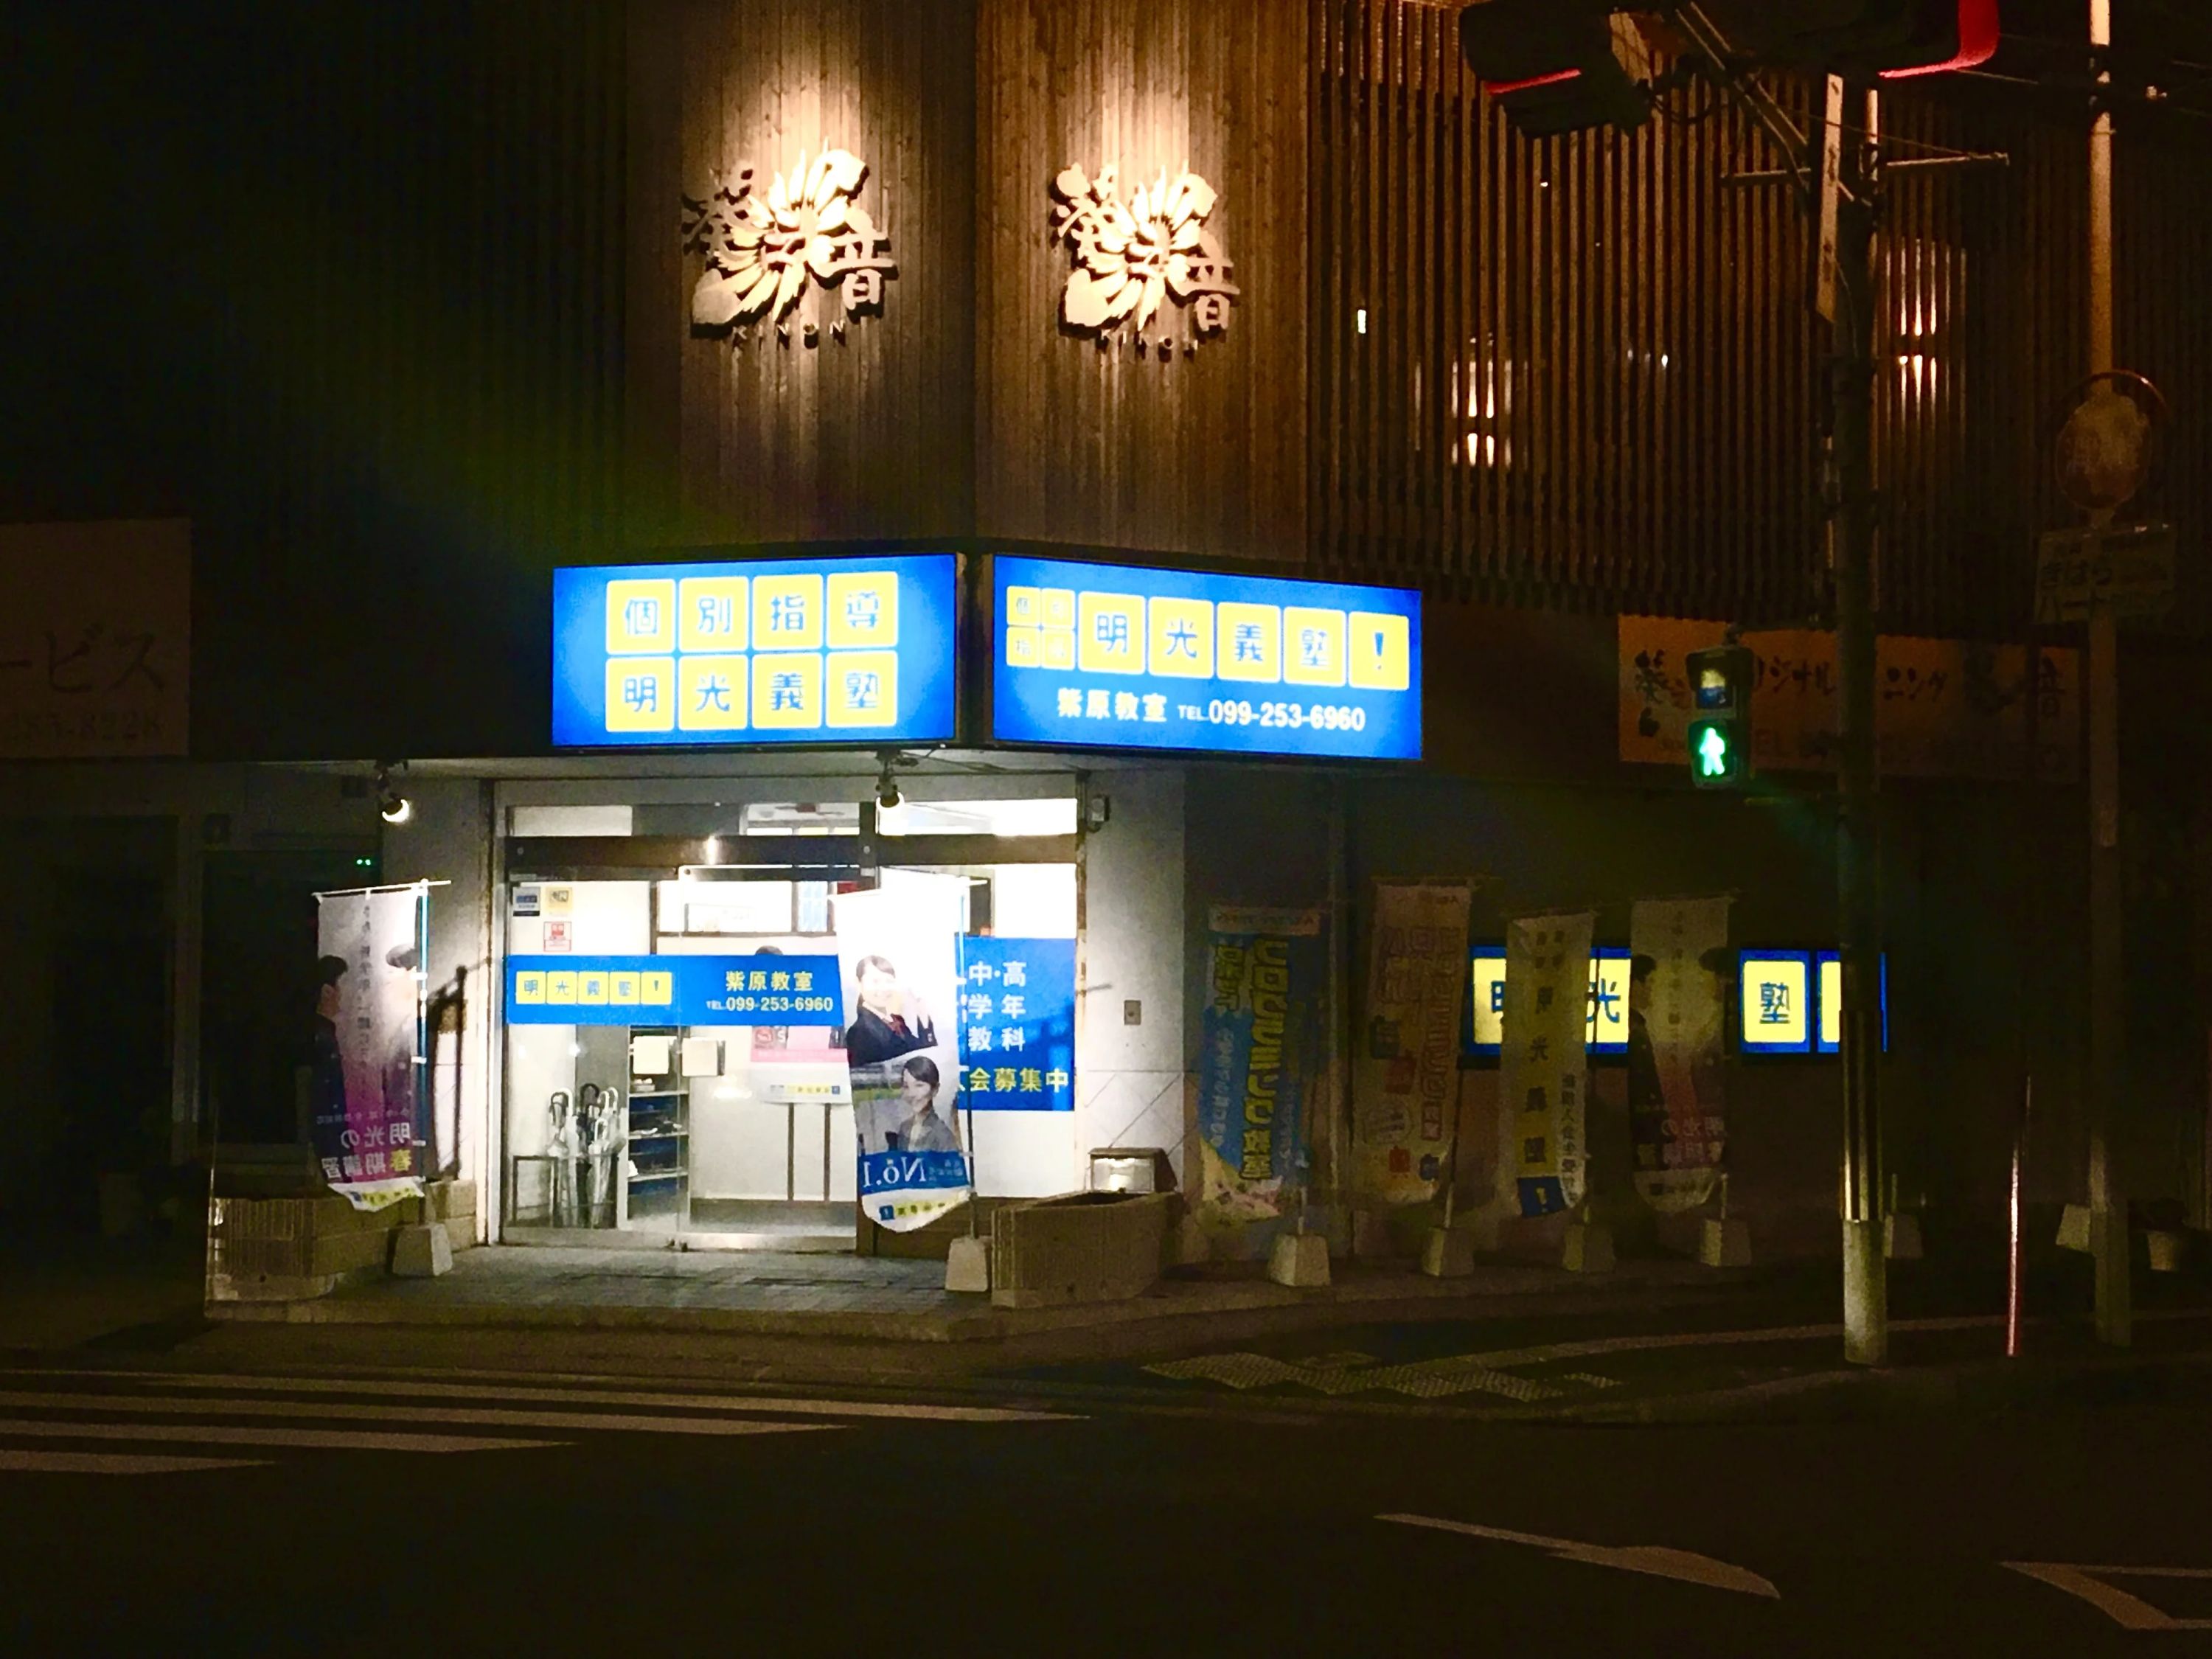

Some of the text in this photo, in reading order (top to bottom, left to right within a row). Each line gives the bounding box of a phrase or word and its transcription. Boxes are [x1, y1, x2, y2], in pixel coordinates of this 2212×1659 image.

[622, 589, 881, 636] 個別指導
[622, 671, 881, 714] 明光義塾
[725, 970, 814, 992] 紫原教室
